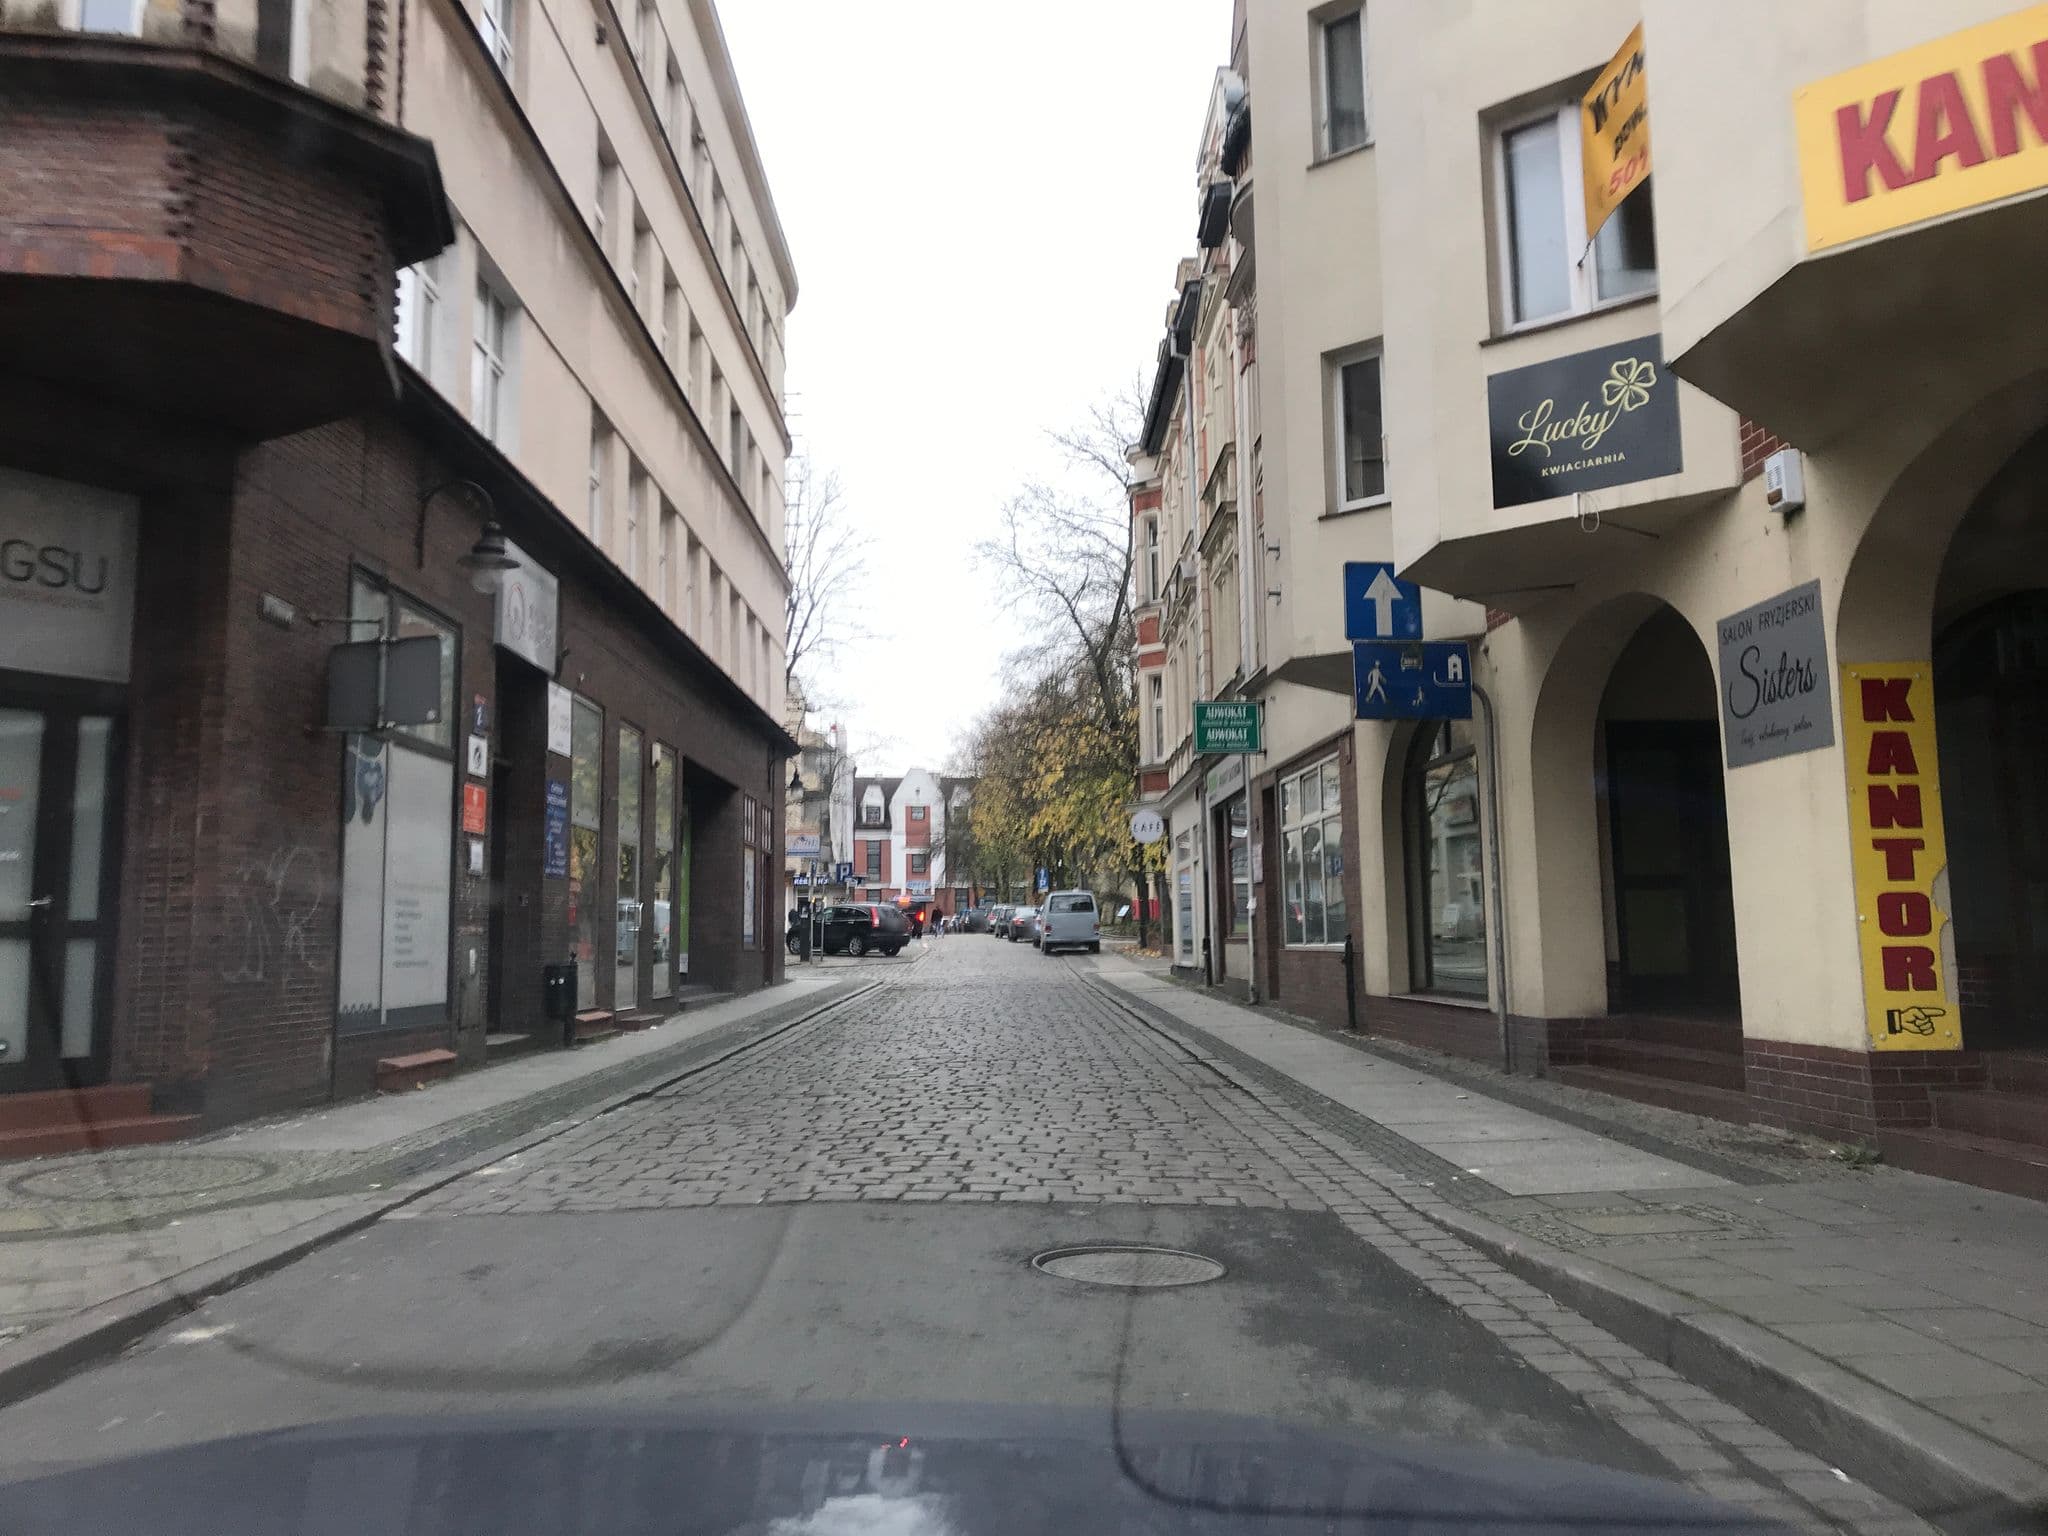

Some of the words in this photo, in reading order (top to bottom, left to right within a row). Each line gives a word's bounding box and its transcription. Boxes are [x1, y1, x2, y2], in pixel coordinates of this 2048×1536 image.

[1835, 38, 2048, 204] KAN
[1508, 398, 1611, 458] Lucky
[1541, 452, 1626, 477] KWIACIARNIA
[1722, 621, 1753, 645] SALON
[1759, 594, 1815, 631] FRYZJERSKI
[1729, 645, 1817, 719] Sisters
[1205, 706, 1248, 719] ADWOKAT
[1206, 728, 1248, 741] ADWOKAT
[1860, 678, 1938, 992] KANTOR
